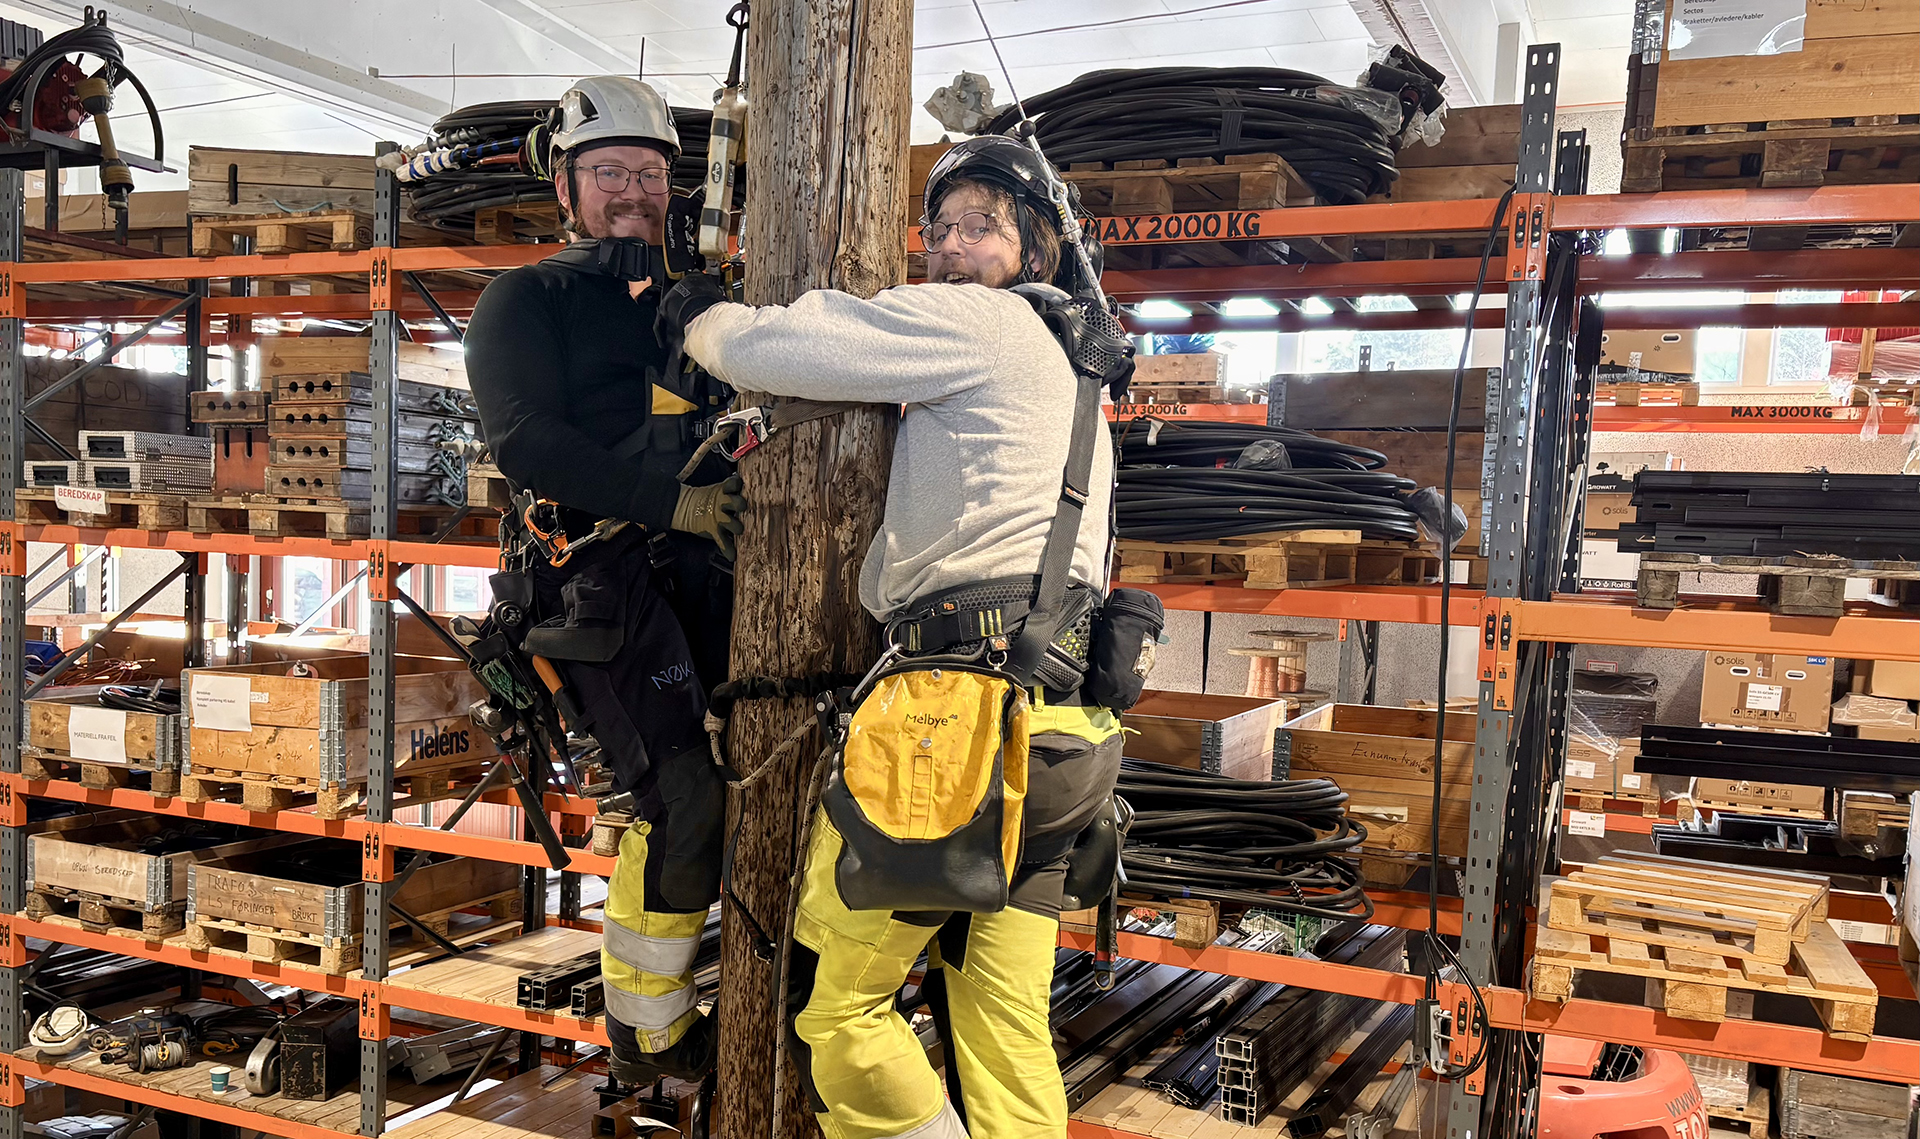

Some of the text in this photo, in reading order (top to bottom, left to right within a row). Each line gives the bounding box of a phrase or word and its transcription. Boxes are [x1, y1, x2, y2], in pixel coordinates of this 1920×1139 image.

[1146, 214, 1221, 240] 2000
[1227, 212, 1261, 238] KG
[1140, 405, 1172, 415] 3000
[1731, 406, 1833, 419] MAX 3000 KG
[58, 487, 102, 502] BEREDSKAP
[1611, 580, 1631, 588] RoHS
[651, 660, 694, 690] NØK
[905, 713, 948, 729] Melbye
[411, 725, 470, 761] Heléns
[291, 907, 318, 923] BRUKT
